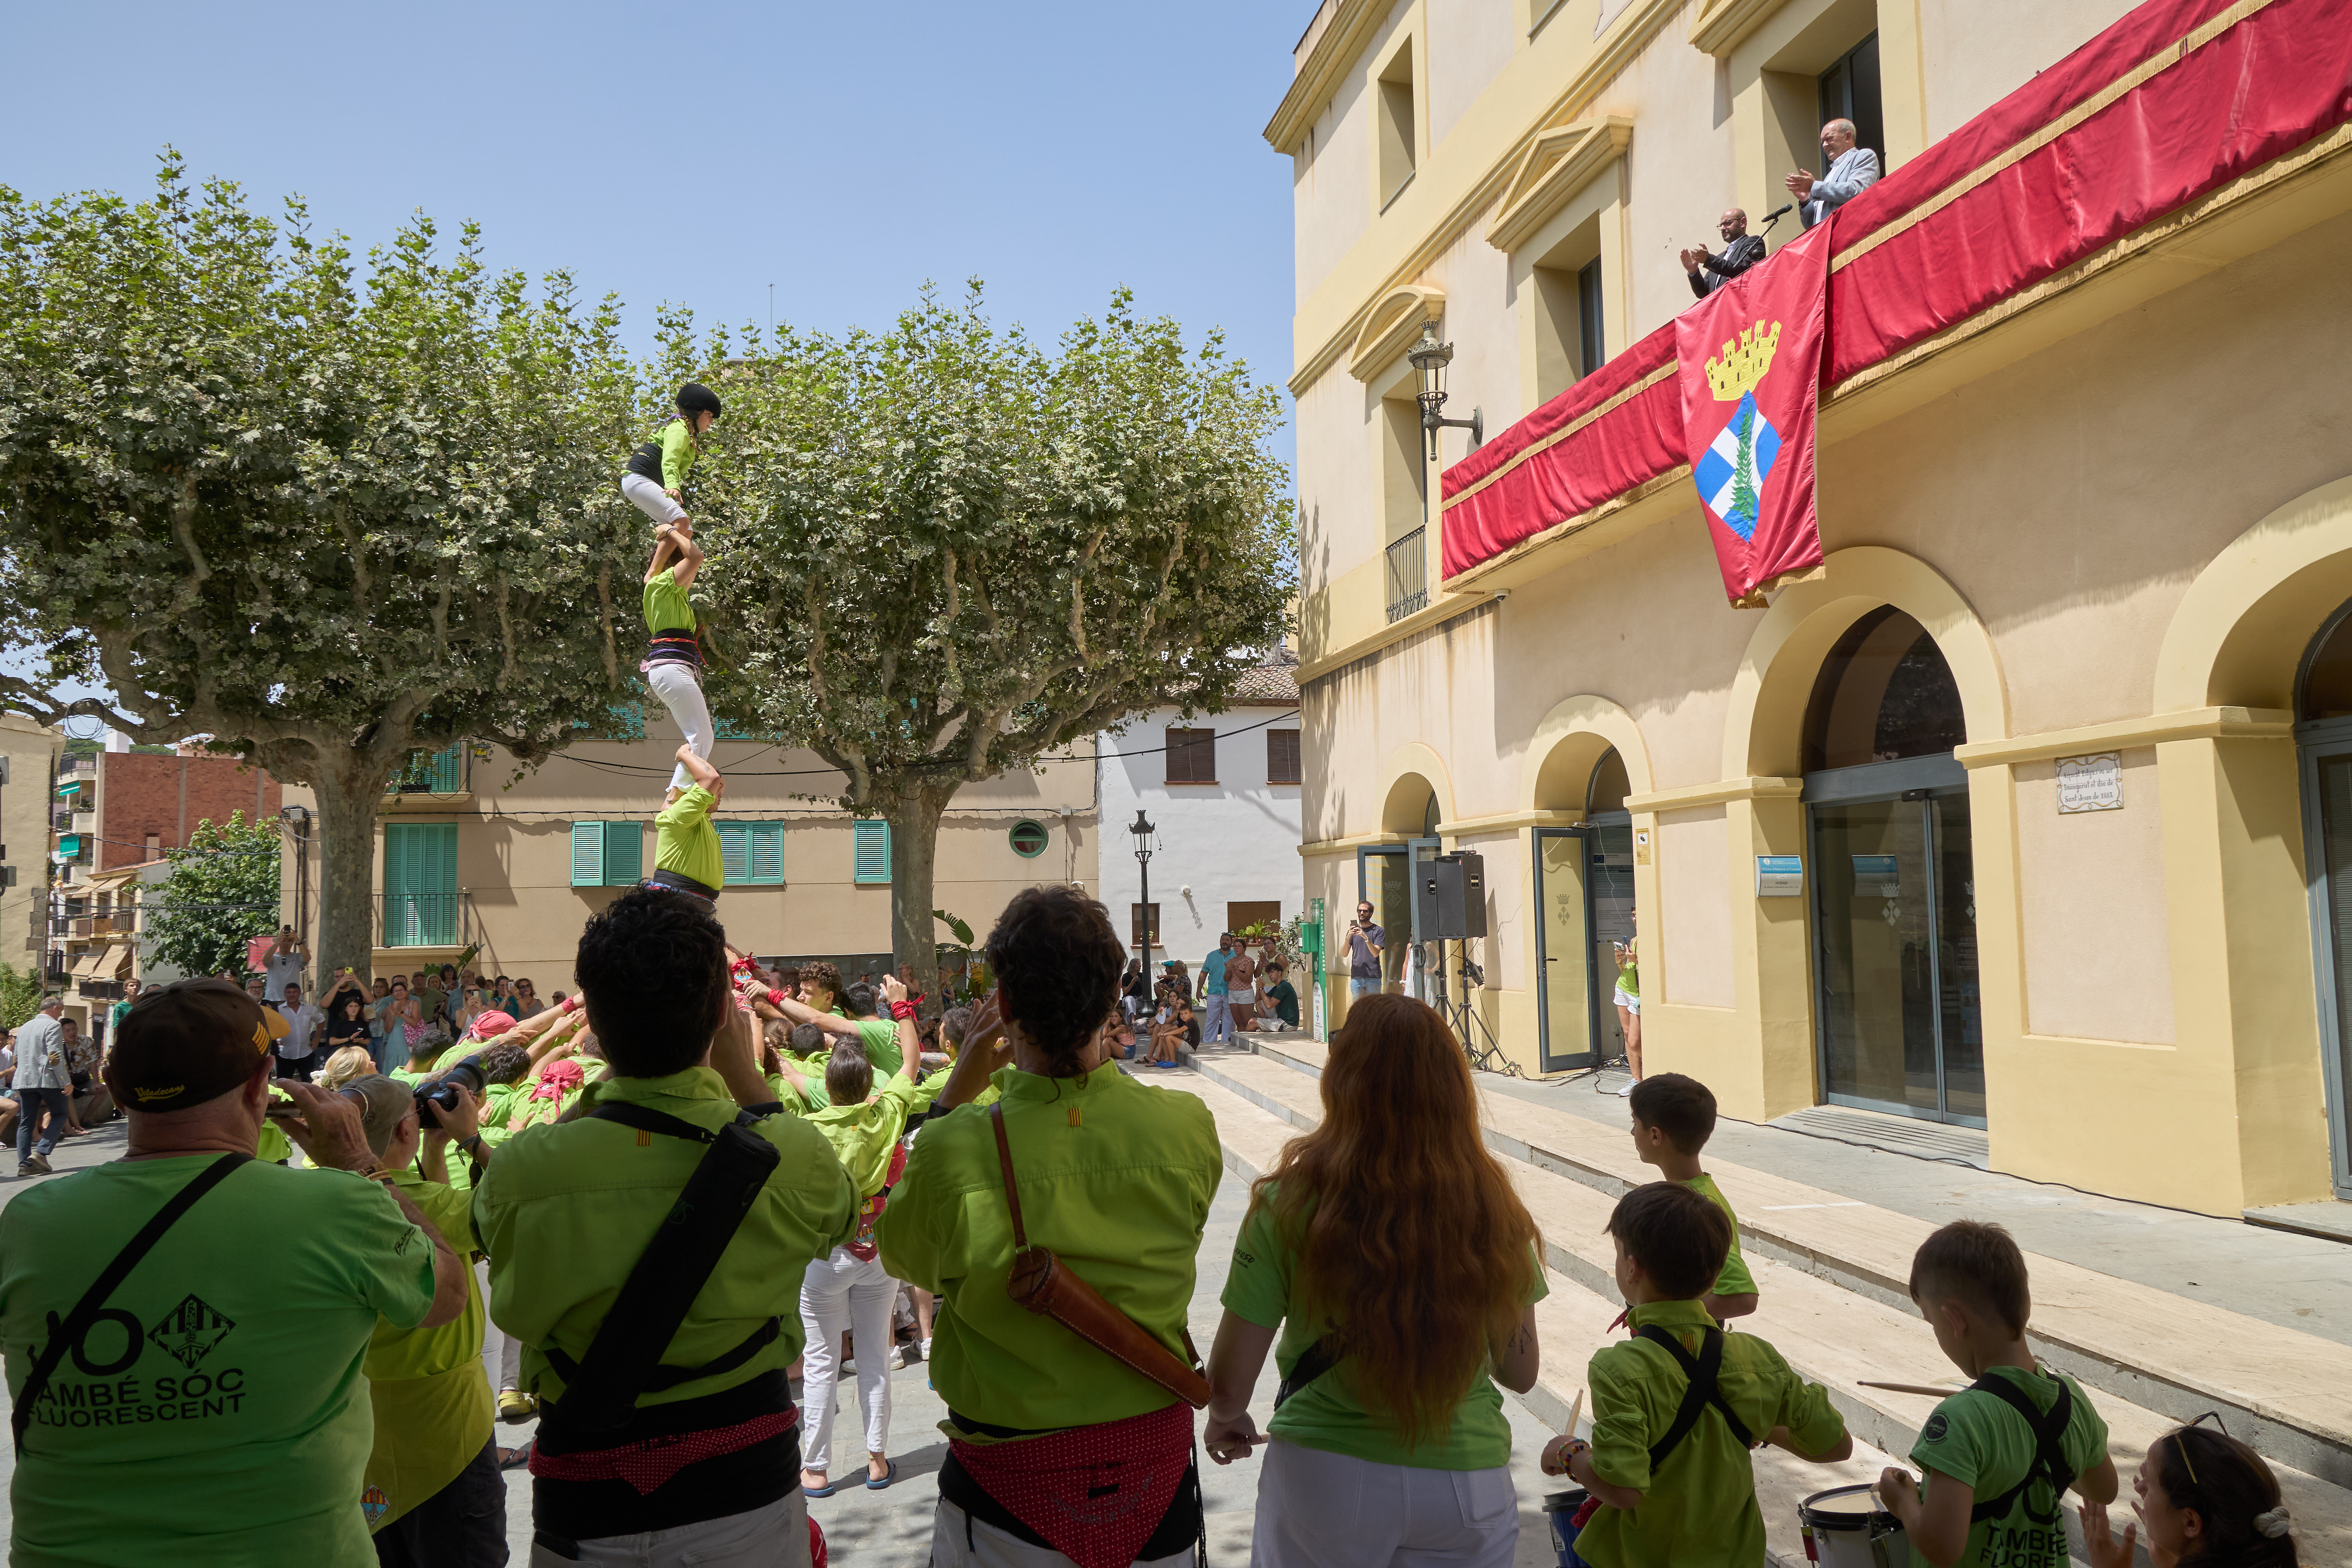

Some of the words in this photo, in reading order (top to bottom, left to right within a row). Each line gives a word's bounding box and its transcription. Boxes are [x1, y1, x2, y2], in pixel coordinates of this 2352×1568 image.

[2065, 794, 2076, 802] Sant
[134, 1084, 185, 1098] Viladecans
[27, 1375, 141, 1408] AMBÉ
[155, 1368, 244, 1401] SÓC
[1050, 1491, 1102, 1524] CASTELLERS
[1105, 1511, 1117, 1523] DE
[1119, 1491, 1142, 1514] SANT
